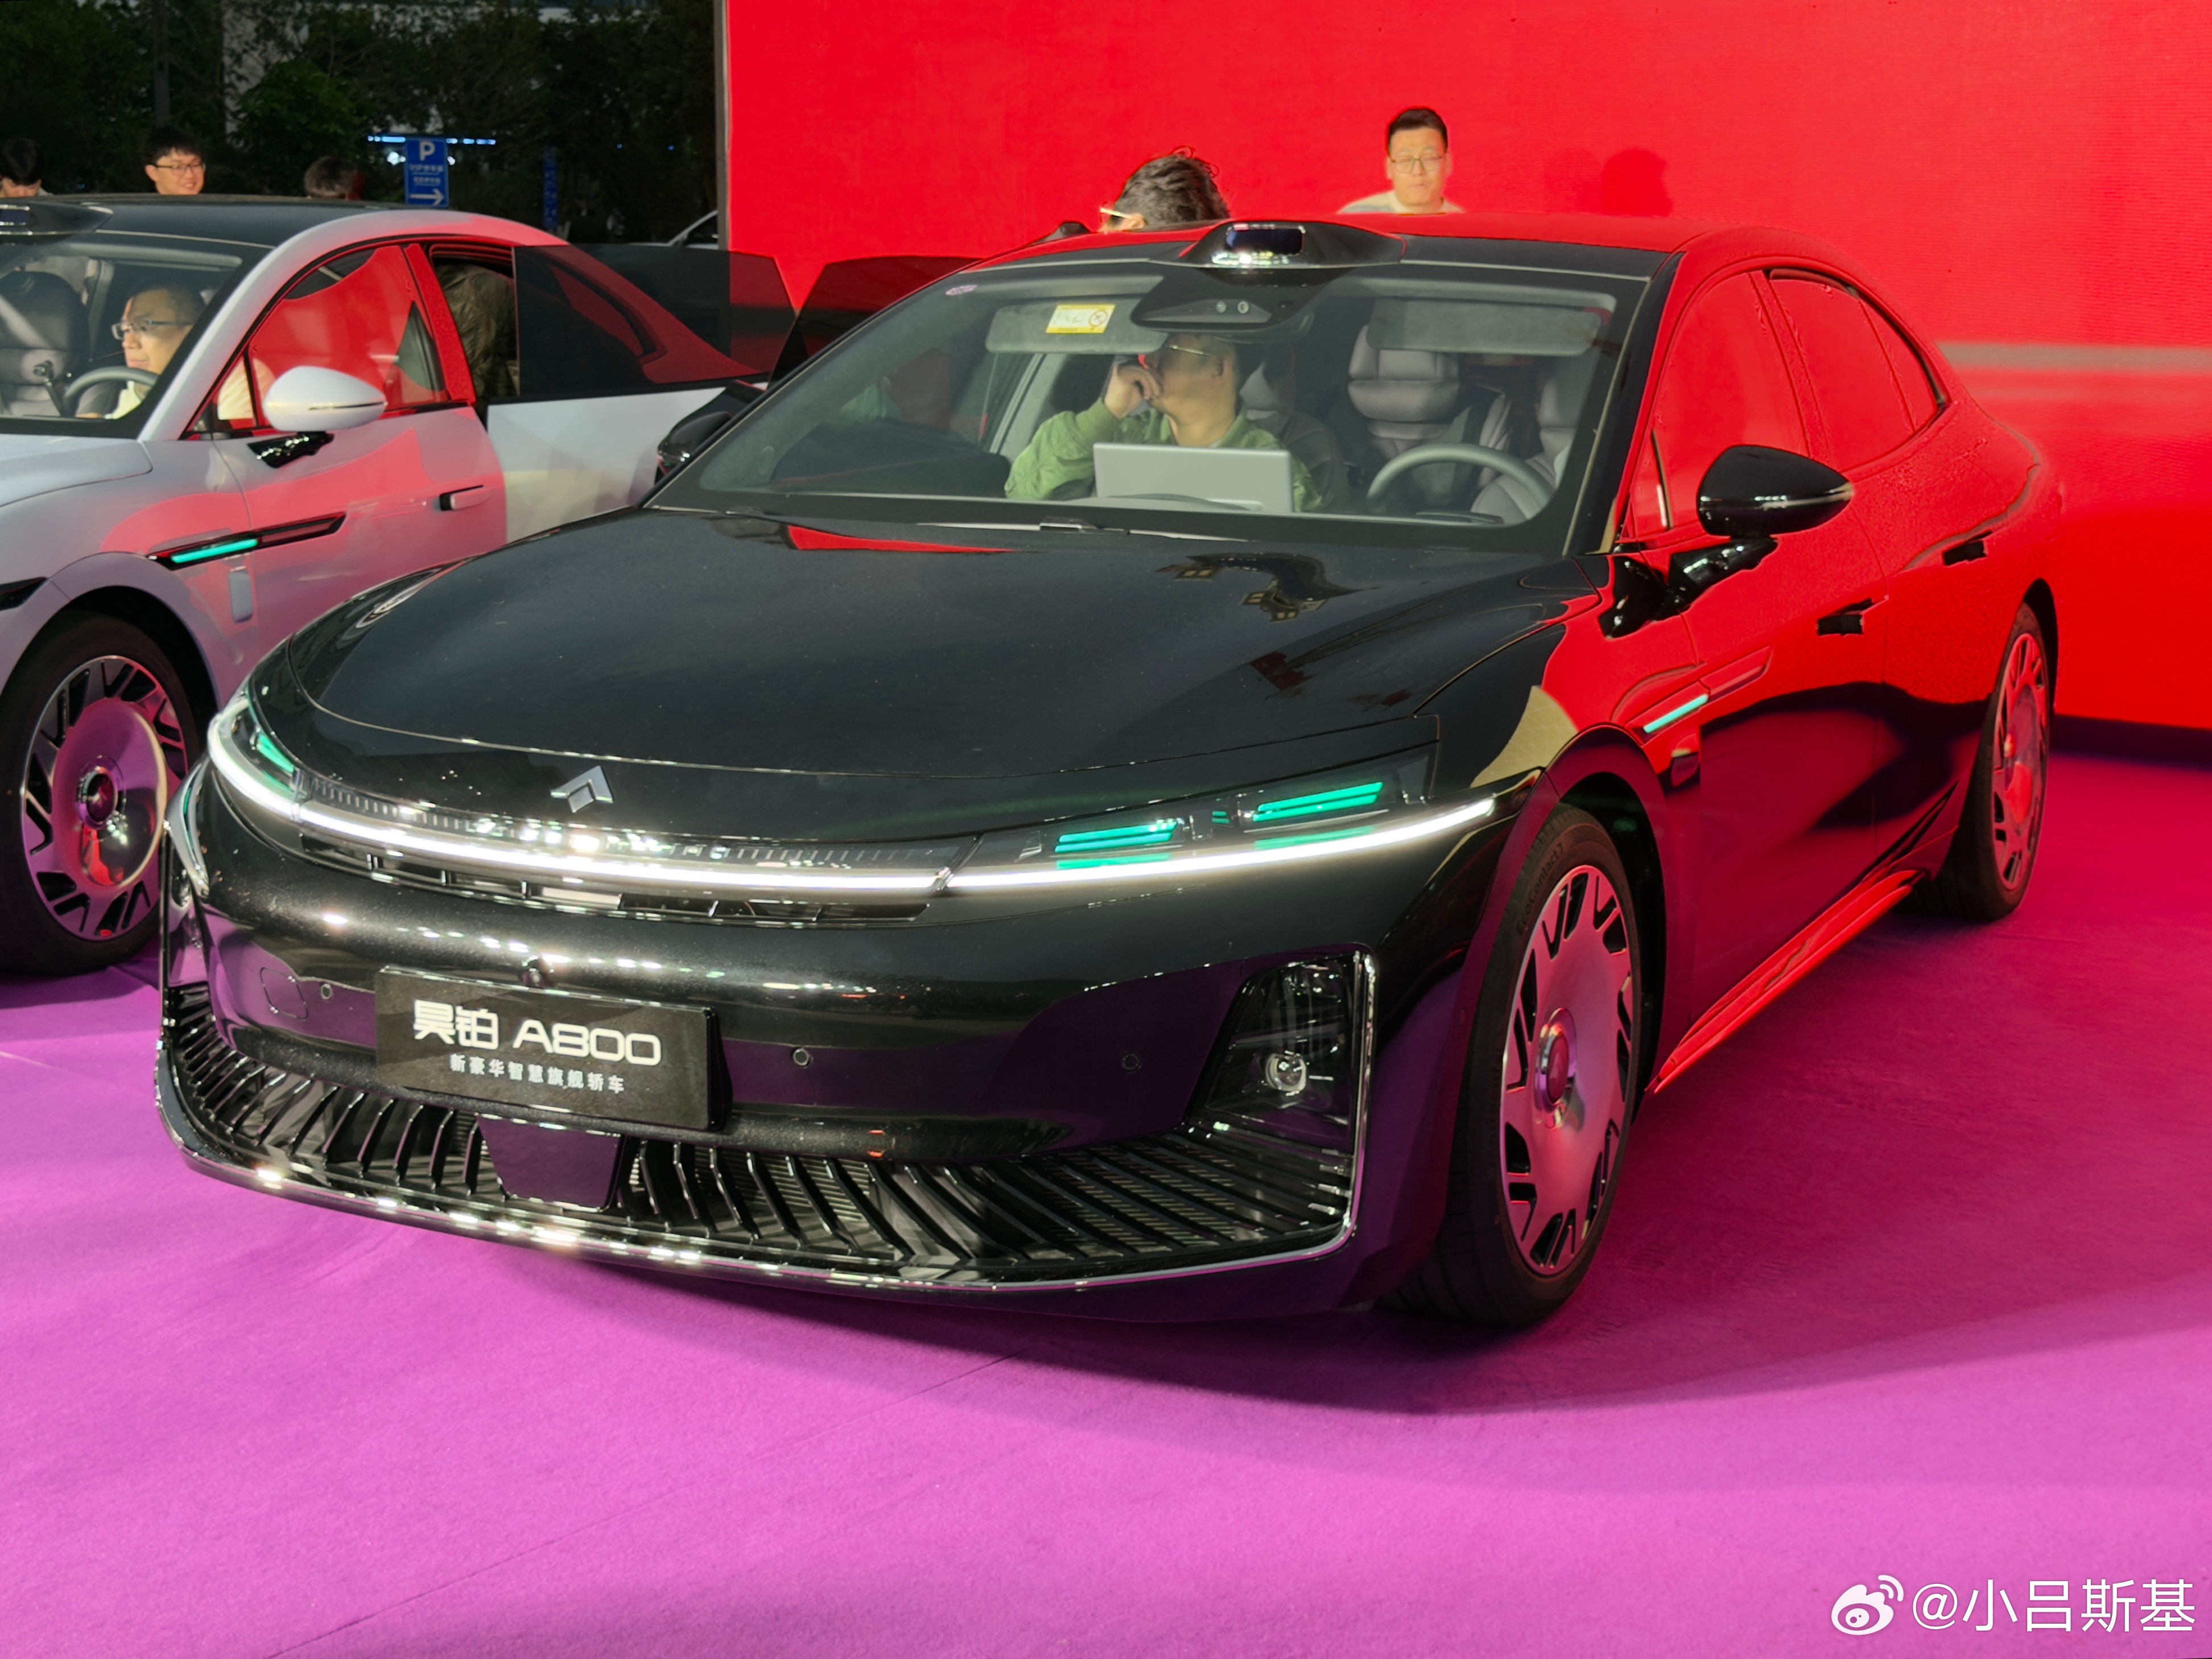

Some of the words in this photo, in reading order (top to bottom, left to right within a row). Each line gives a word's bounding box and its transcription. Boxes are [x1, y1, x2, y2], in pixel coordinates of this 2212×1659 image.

[420, 141, 435, 161] P
[1516, 851, 1558, 935] EcoContact
[1557, 842, 1563, 853] 7
[414, 1000, 499, 1050] 昊铂
[513, 1019, 661, 1067] A800
[450, 1054, 625, 1094] 新豪华智慧旗舰轿车
